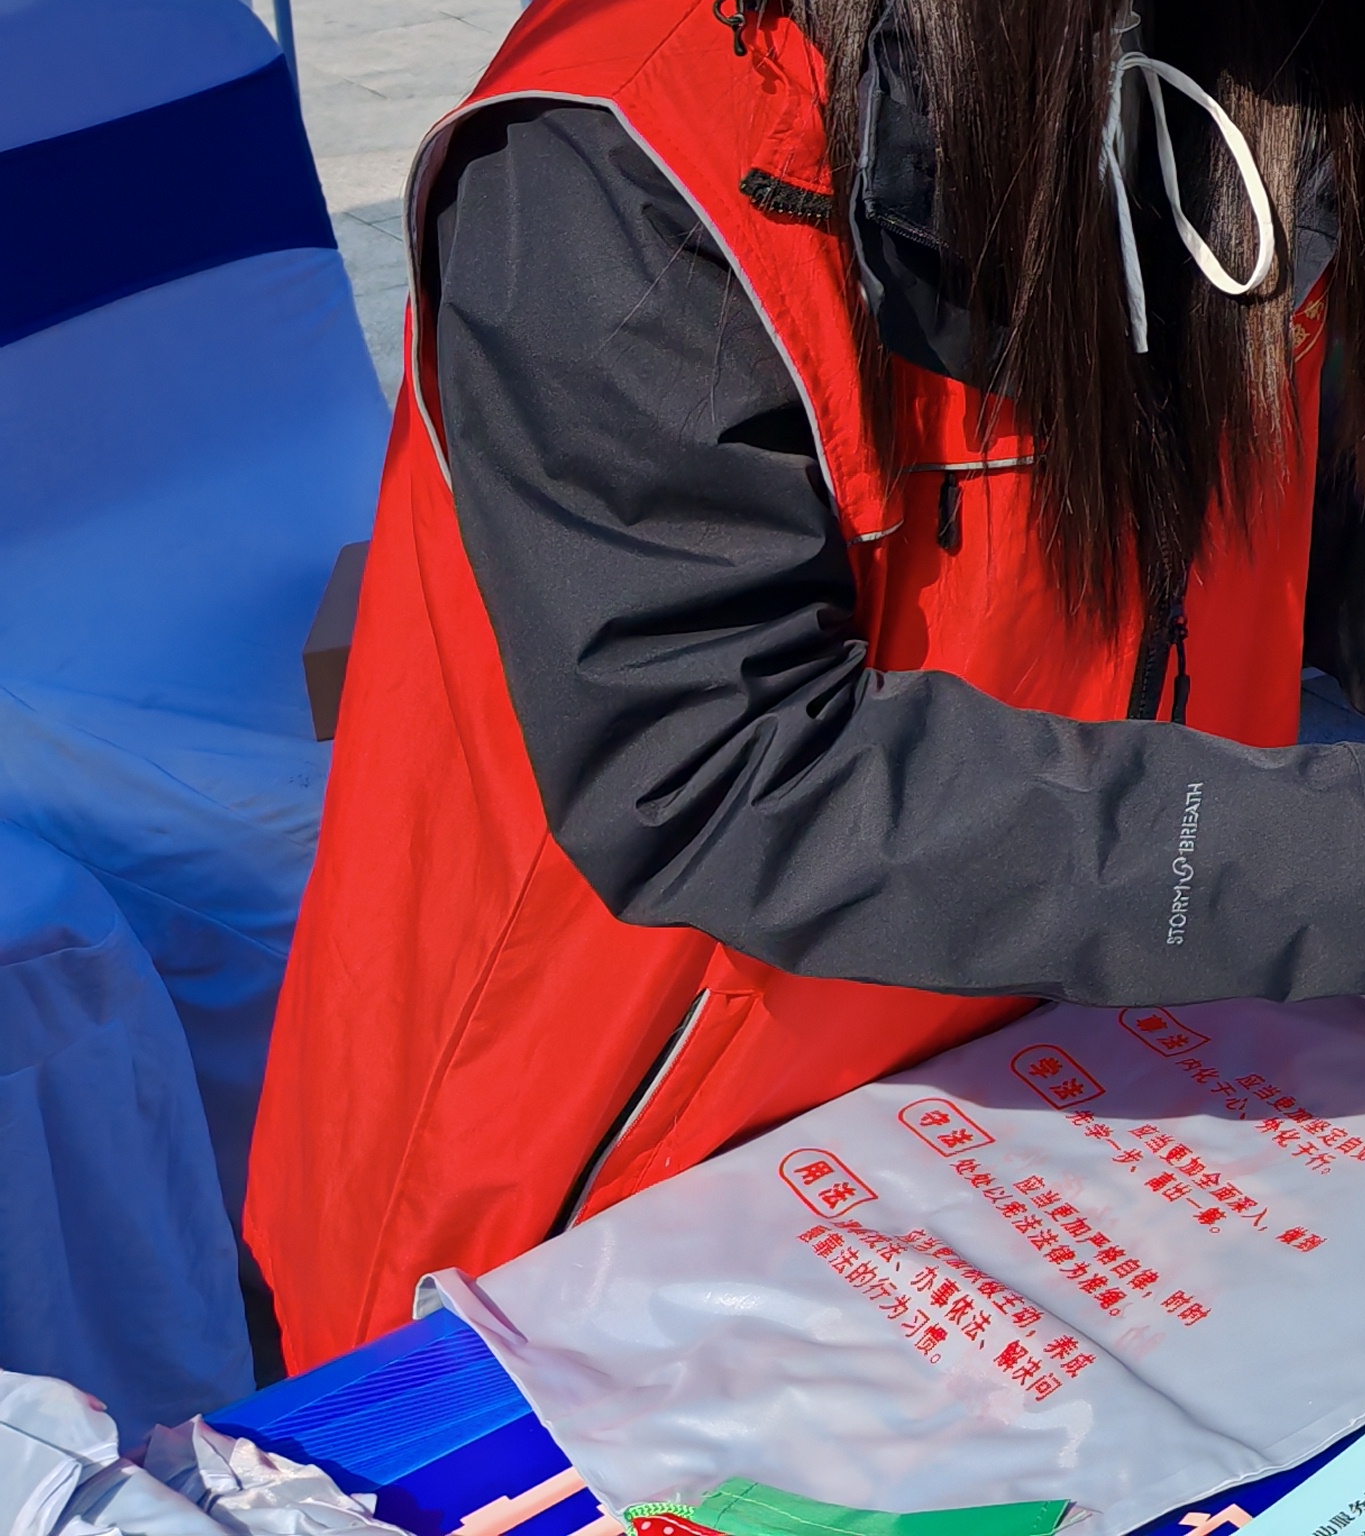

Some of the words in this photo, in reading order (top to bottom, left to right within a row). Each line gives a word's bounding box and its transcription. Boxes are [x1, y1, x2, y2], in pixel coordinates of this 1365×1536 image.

[1166, 885, 1191, 945] STORM
[1179, 782, 1204, 852] BREATH
[1028, 1055, 1086, 1106] 学法
[917, 1110, 976, 1152] 守法
[792, 1160, 859, 1212] 用法
[1011, 1174, 1213, 1327] 应当更加严格自律，时时
